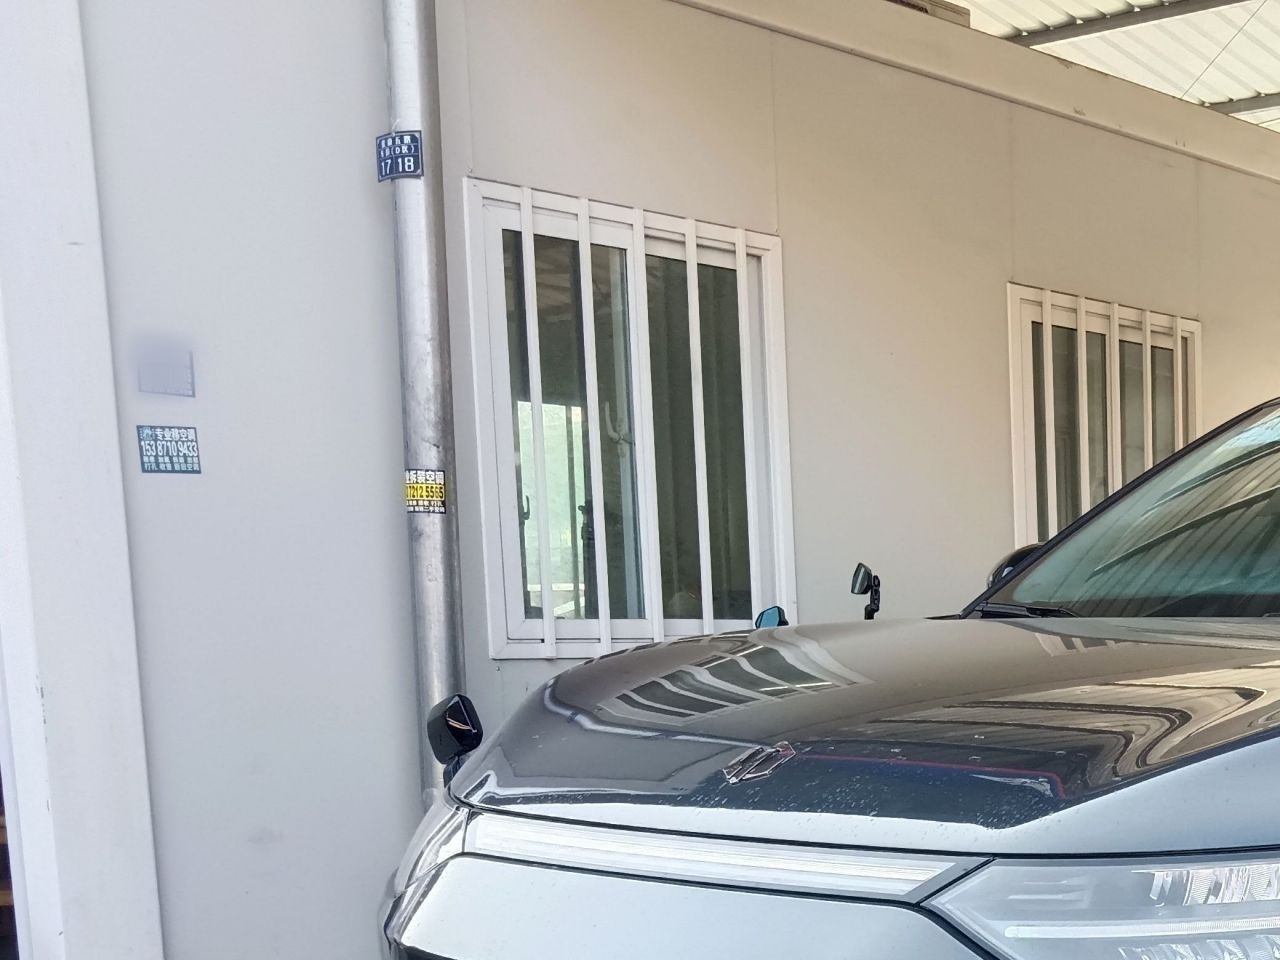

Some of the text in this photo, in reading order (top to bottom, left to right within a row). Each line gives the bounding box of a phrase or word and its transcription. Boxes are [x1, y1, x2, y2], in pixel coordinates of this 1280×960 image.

[381, 157, 414, 176] 17 18
[140, 440, 156, 456] 153
[157, 440, 177, 456] 8710
